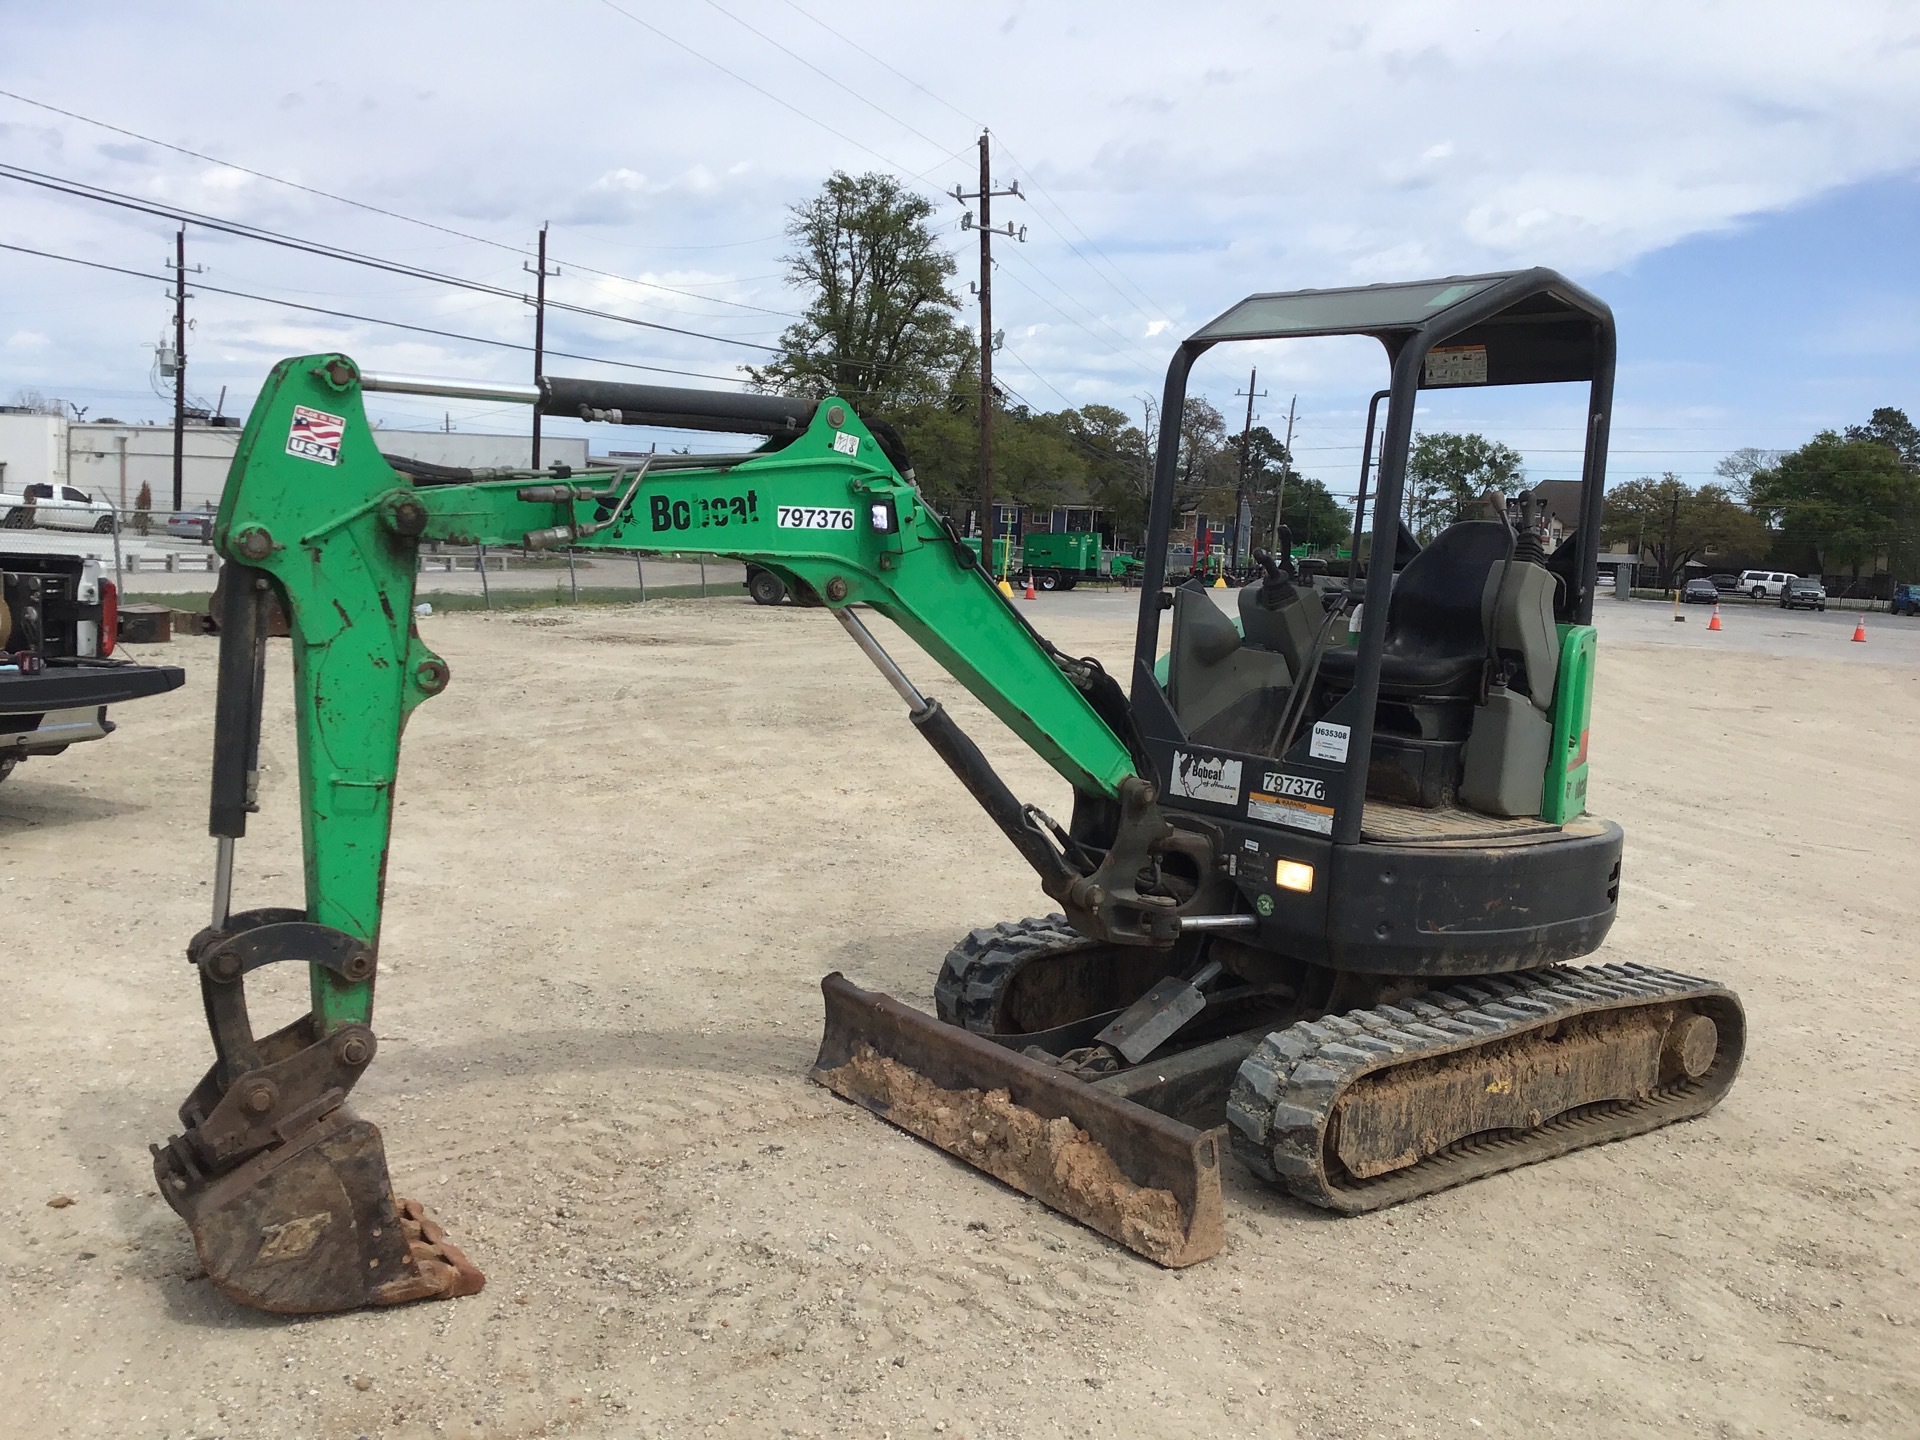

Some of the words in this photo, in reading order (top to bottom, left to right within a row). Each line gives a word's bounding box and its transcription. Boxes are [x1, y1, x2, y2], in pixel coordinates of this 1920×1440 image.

[290, 438, 334, 460] USA
[779, 508, 853, 529] 797376
[1315, 727, 1348, 740] U635308
[1192, 765, 1222, 781] Bobcat
[1265, 773, 1324, 799] 797376
